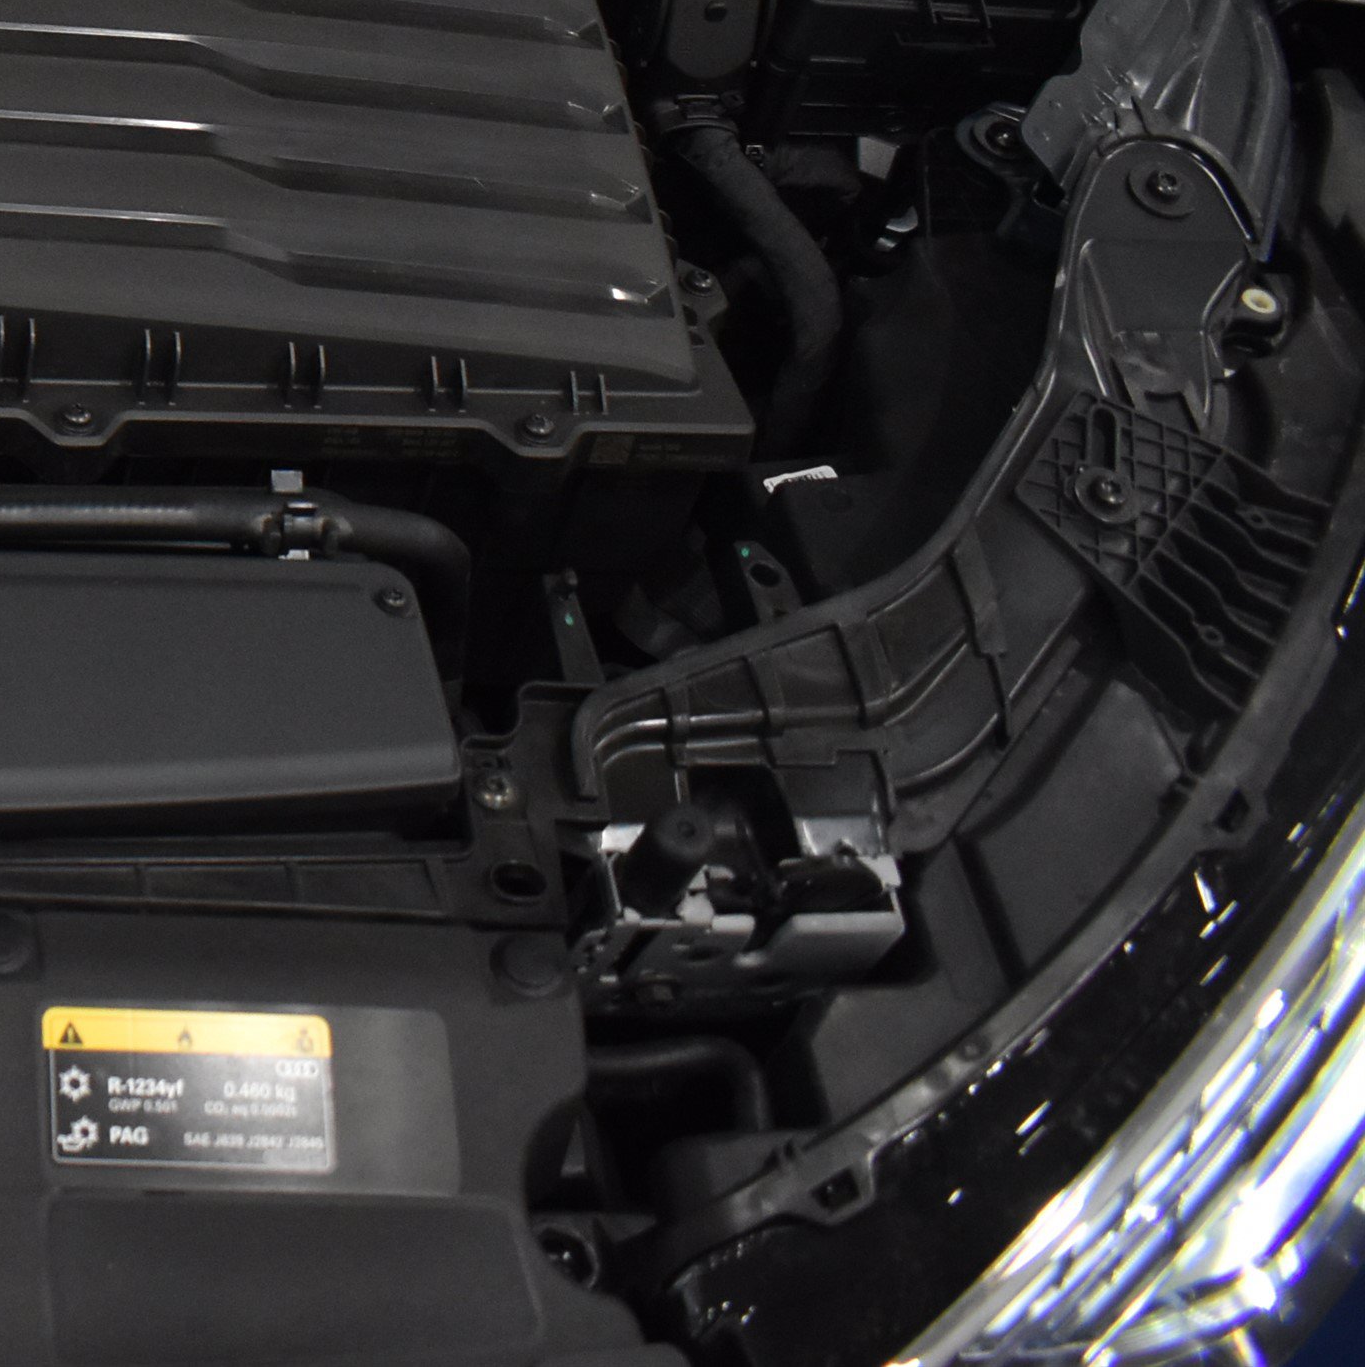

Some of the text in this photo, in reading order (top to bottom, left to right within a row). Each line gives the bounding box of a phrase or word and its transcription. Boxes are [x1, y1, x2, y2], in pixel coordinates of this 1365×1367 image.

[107, 1076, 185, 1098] R-1234yf
[275, 1083, 297, 1102] kg
[109, 1126, 149, 1146] PAG
